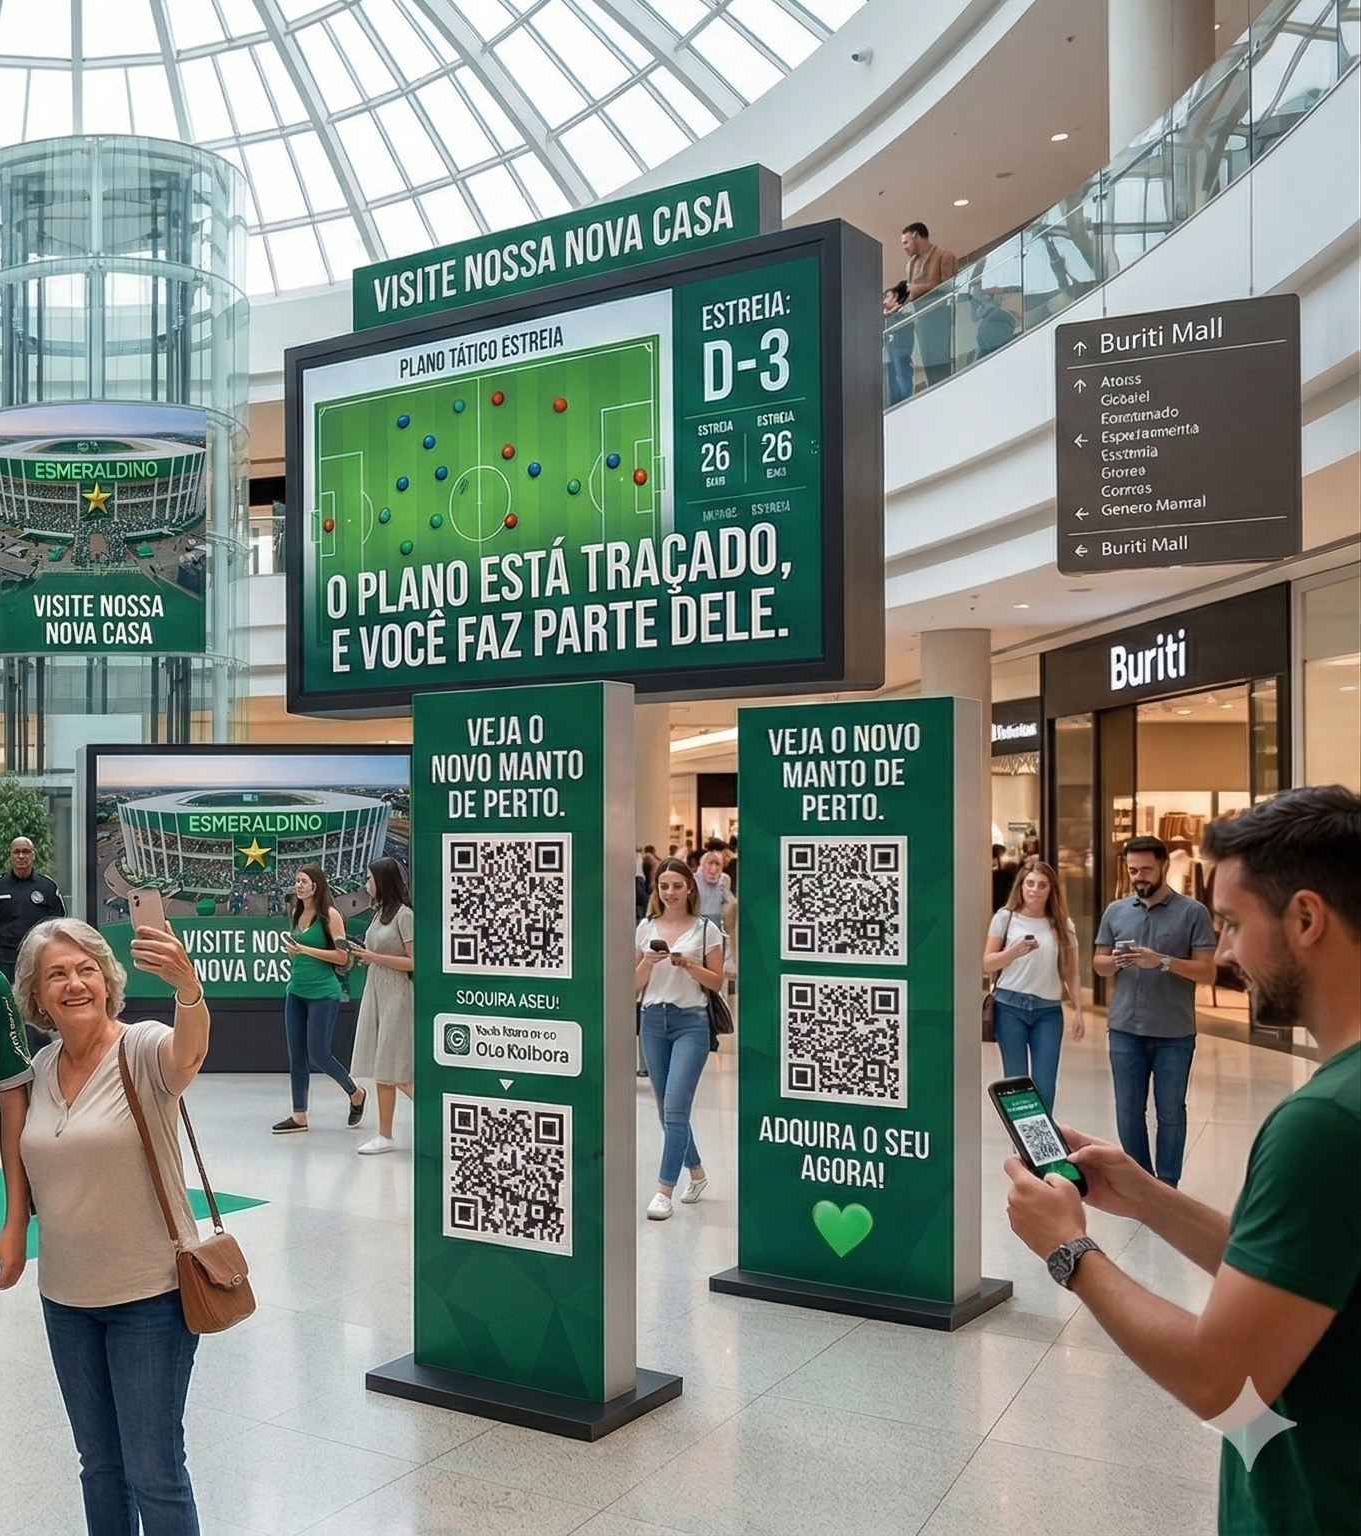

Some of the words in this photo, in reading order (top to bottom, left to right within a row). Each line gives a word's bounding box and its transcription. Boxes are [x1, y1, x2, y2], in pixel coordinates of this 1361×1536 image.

[374, 259, 457, 313] VISITE
[465, 236, 556, 293] NOSSA
[565, 214, 643, 268] NOVA
[653, 190, 733, 246] CASA
[702, 290, 791, 331] ESTREIA:
[1100, 325, 1164, 354] Buriti
[1172, 316, 1224, 344] Mall
[400, 350, 445, 379] PLANO
[449, 338, 498, 372] TÁTICO
[704, 328, 789, 402] D-3
[701, 440, 730, 473] 26
[761, 430, 792, 463] 26
[35, 461, 158, 480] ESMERALDINO
[1101, 502, 1153, 516] Genero
[1101, 538, 1147, 556] Buriti
[1152, 534, 1188, 552] Mall
[326, 574, 348, 619] O
[358, 559, 468, 615] PLANO
[481, 537, 570, 603] ESTÁ
[580, 522, 792, 600] TRAÇADO,
[33, 594, 94, 617] VISITE
[100, 595, 164, 617] NOSSA
[46, 622, 97, 644] NOVA
[103, 622, 153, 644] CASA
[332, 629, 350, 673] E
[359, 609, 447, 669] VOCÊ
[458, 611, 522, 662] FAZ
[535, 599, 658, 657] PARTE
[671, 586, 788, 645] DELE.
[1110, 628, 1187, 691] Buriti
[467, 716, 522, 746] VEJA
[529, 714, 544, 744] O
[768, 727, 824, 756] VEJA
[831, 726, 847, 754] O
[853, 723, 920, 753] NOVO
[431, 753, 492, 783] NOVO
[499, 749, 584, 781] MANTO
[783, 759, 866, 788] MANTO
[875, 758, 905, 786] DE
[448, 789, 477, 819] DE
[483, 787, 566, 818] PERTO.
[802, 793, 885, 821] PERTO.
[189, 814, 322, 832] ESMERALDINO
[182, 930, 246, 954] VISITE
[252, 930, 292, 954] NOS
[193, 958, 247, 982] NOVA
[254, 958, 292, 982] CAS
[759, 1116, 857, 1151] ADQUIRA
[863, 1126, 877, 1154] O
[885, 1128, 930, 1160] SEU
[801, 1154, 885, 1189] AGORA!
